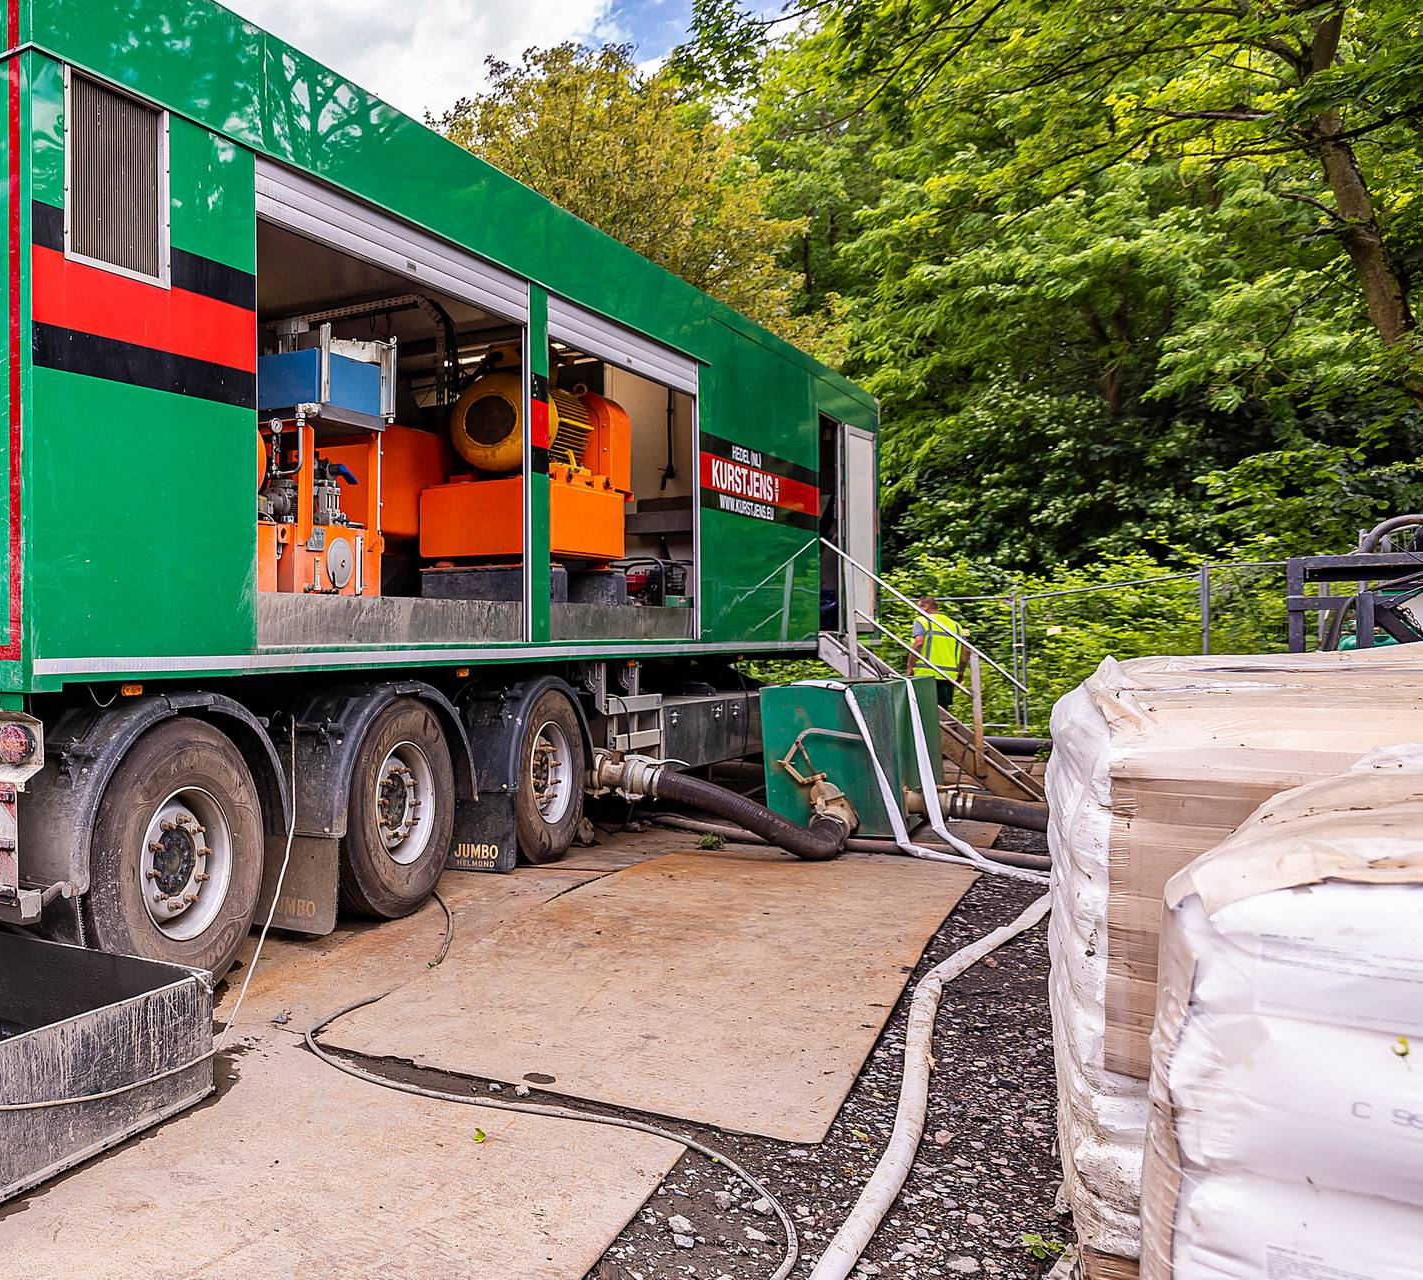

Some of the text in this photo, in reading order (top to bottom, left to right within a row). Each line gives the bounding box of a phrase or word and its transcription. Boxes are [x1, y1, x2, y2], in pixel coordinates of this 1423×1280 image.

[711, 458, 774, 502] KURSTJENS
[453, 843, 499, 860] JUMBO
[456, 859, 495, 868] HELMOND
